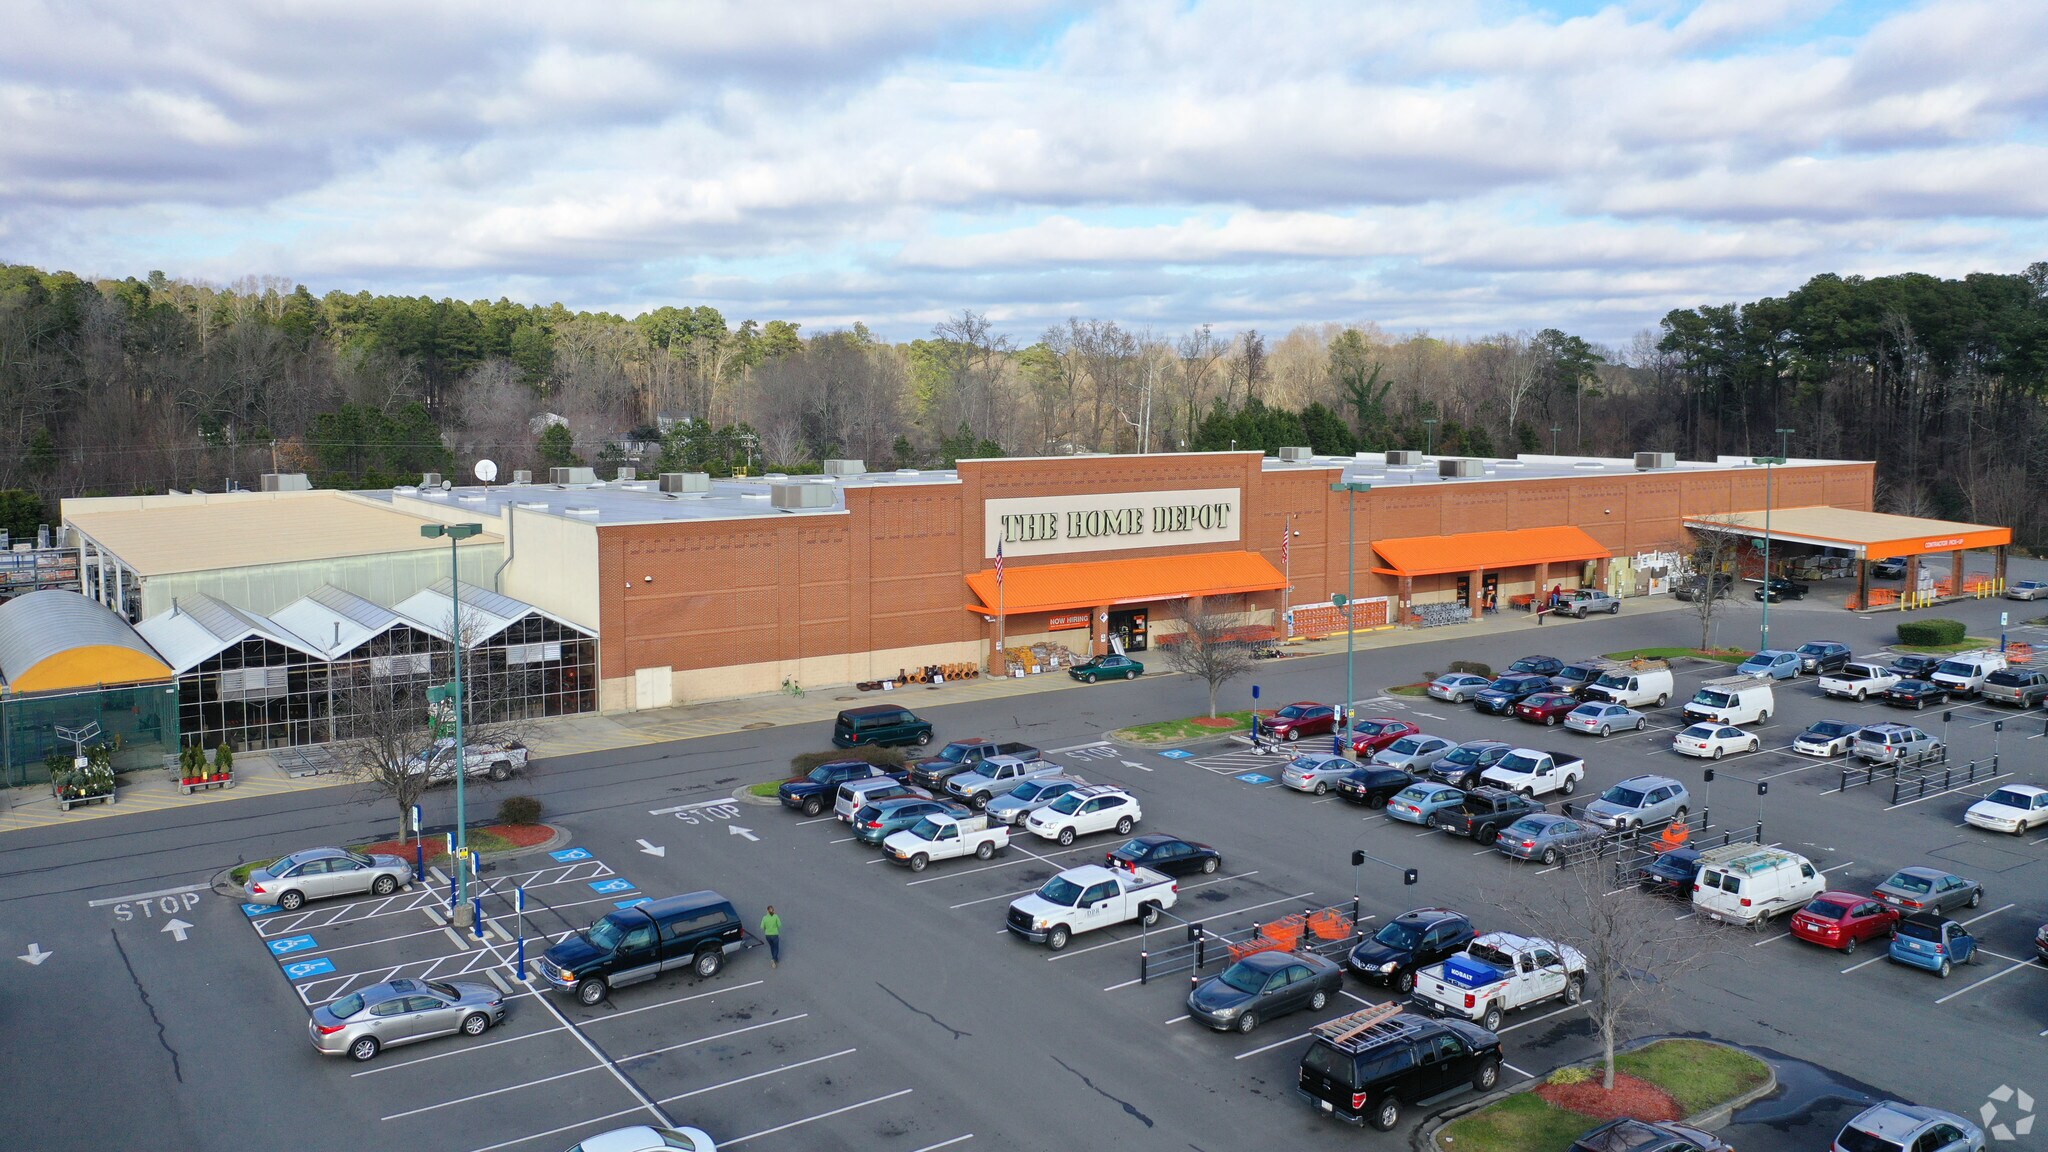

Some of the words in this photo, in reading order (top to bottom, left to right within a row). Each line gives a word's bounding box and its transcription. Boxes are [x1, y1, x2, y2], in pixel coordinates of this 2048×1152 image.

[1001, 512, 1059, 543] THE
[1066, 507, 1144, 538] HOME
[1152, 502, 1232, 533] DEPOT
[1049, 617, 1066, 625] NOW
[1066, 615, 1089, 624] HIRING
[1065, 746, 1123, 762] STOP
[674, 804, 741, 825] STOP
[113, 892, 200, 921] STOP
[1451, 968, 1473, 981] KOBALT
